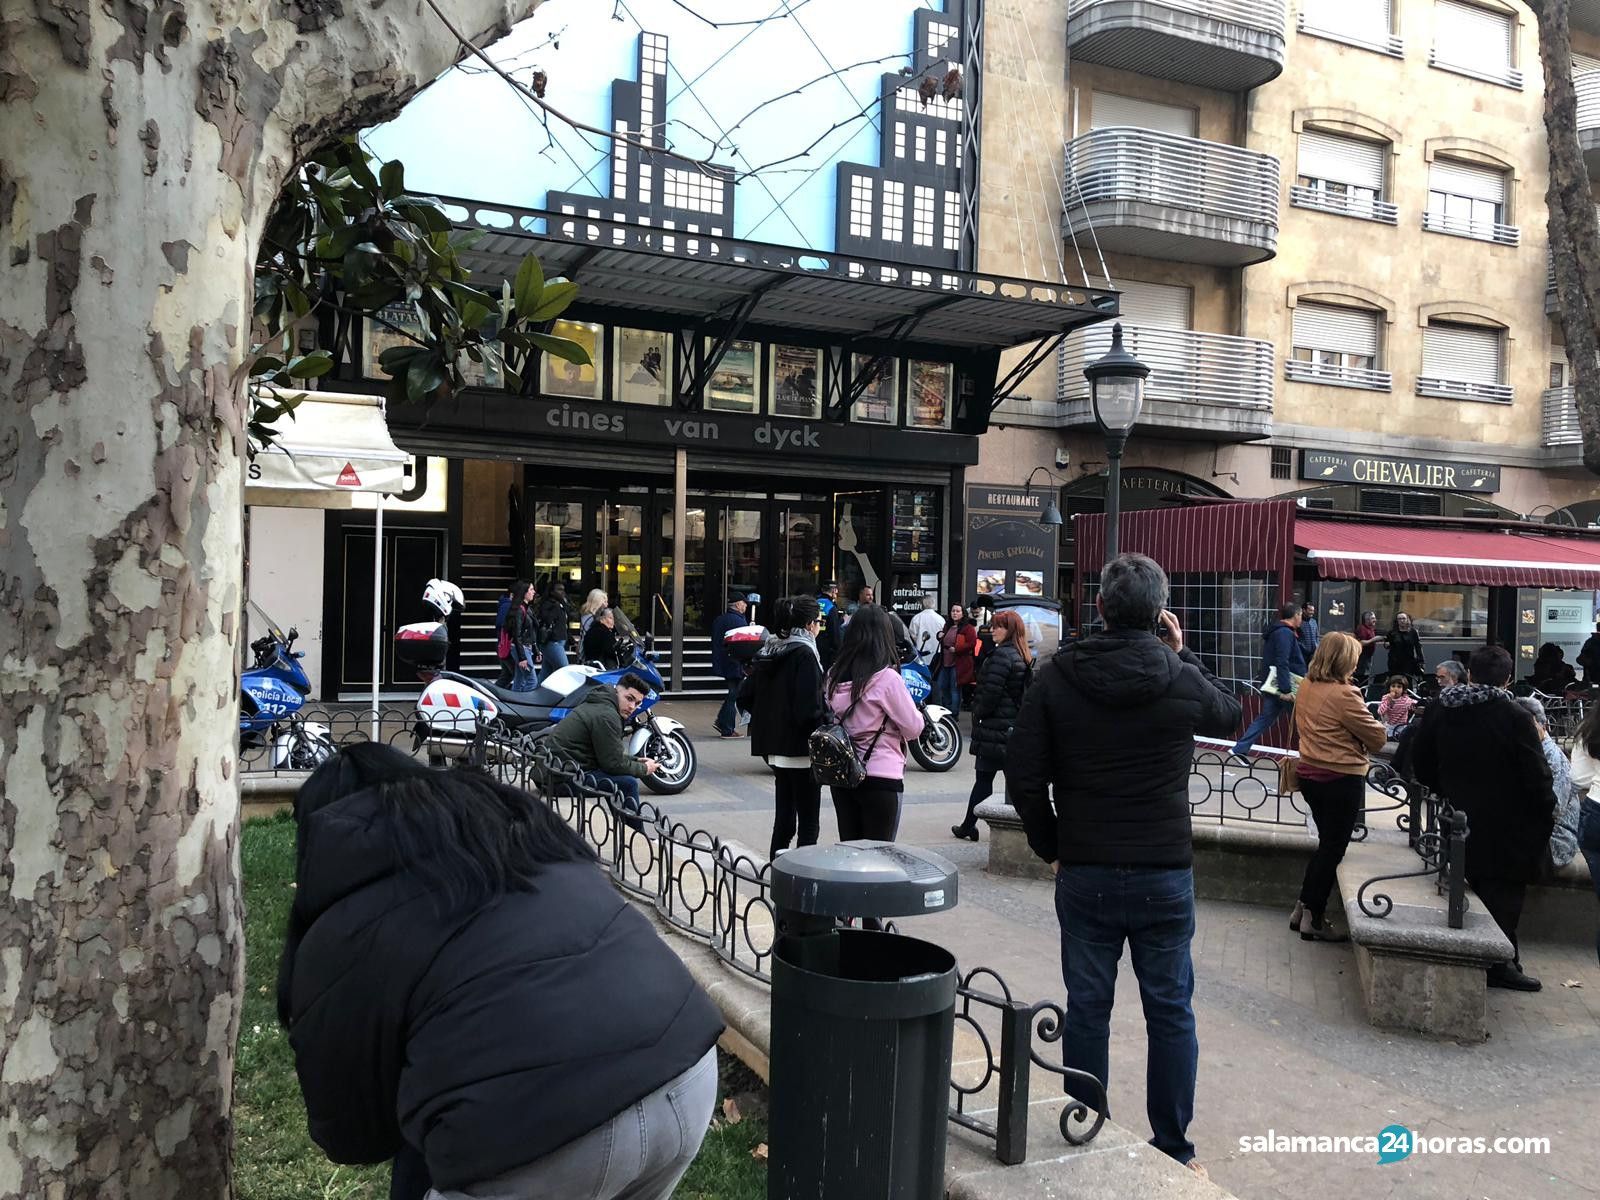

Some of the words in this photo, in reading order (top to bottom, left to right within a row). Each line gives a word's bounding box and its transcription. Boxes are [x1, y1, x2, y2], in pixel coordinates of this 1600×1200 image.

[546, 403, 625, 433] cines
[664, 419, 719, 440] van
[754, 421, 820, 450] dyck
[1309, 456, 1348, 467] CAFETERIA
[1353, 459, 1457, 488] CHEVALIER
[1461, 468, 1496, 479] CAFETERIA
[1107, 477, 1182, 494] AFETERIA
[987, 493, 1040, 507] RESTAURANTE
[893, 586, 925, 597] entradas
[909, 686, 923, 697] 112
[281, 692, 303, 705] Local
[263, 702, 287, 715] 112
